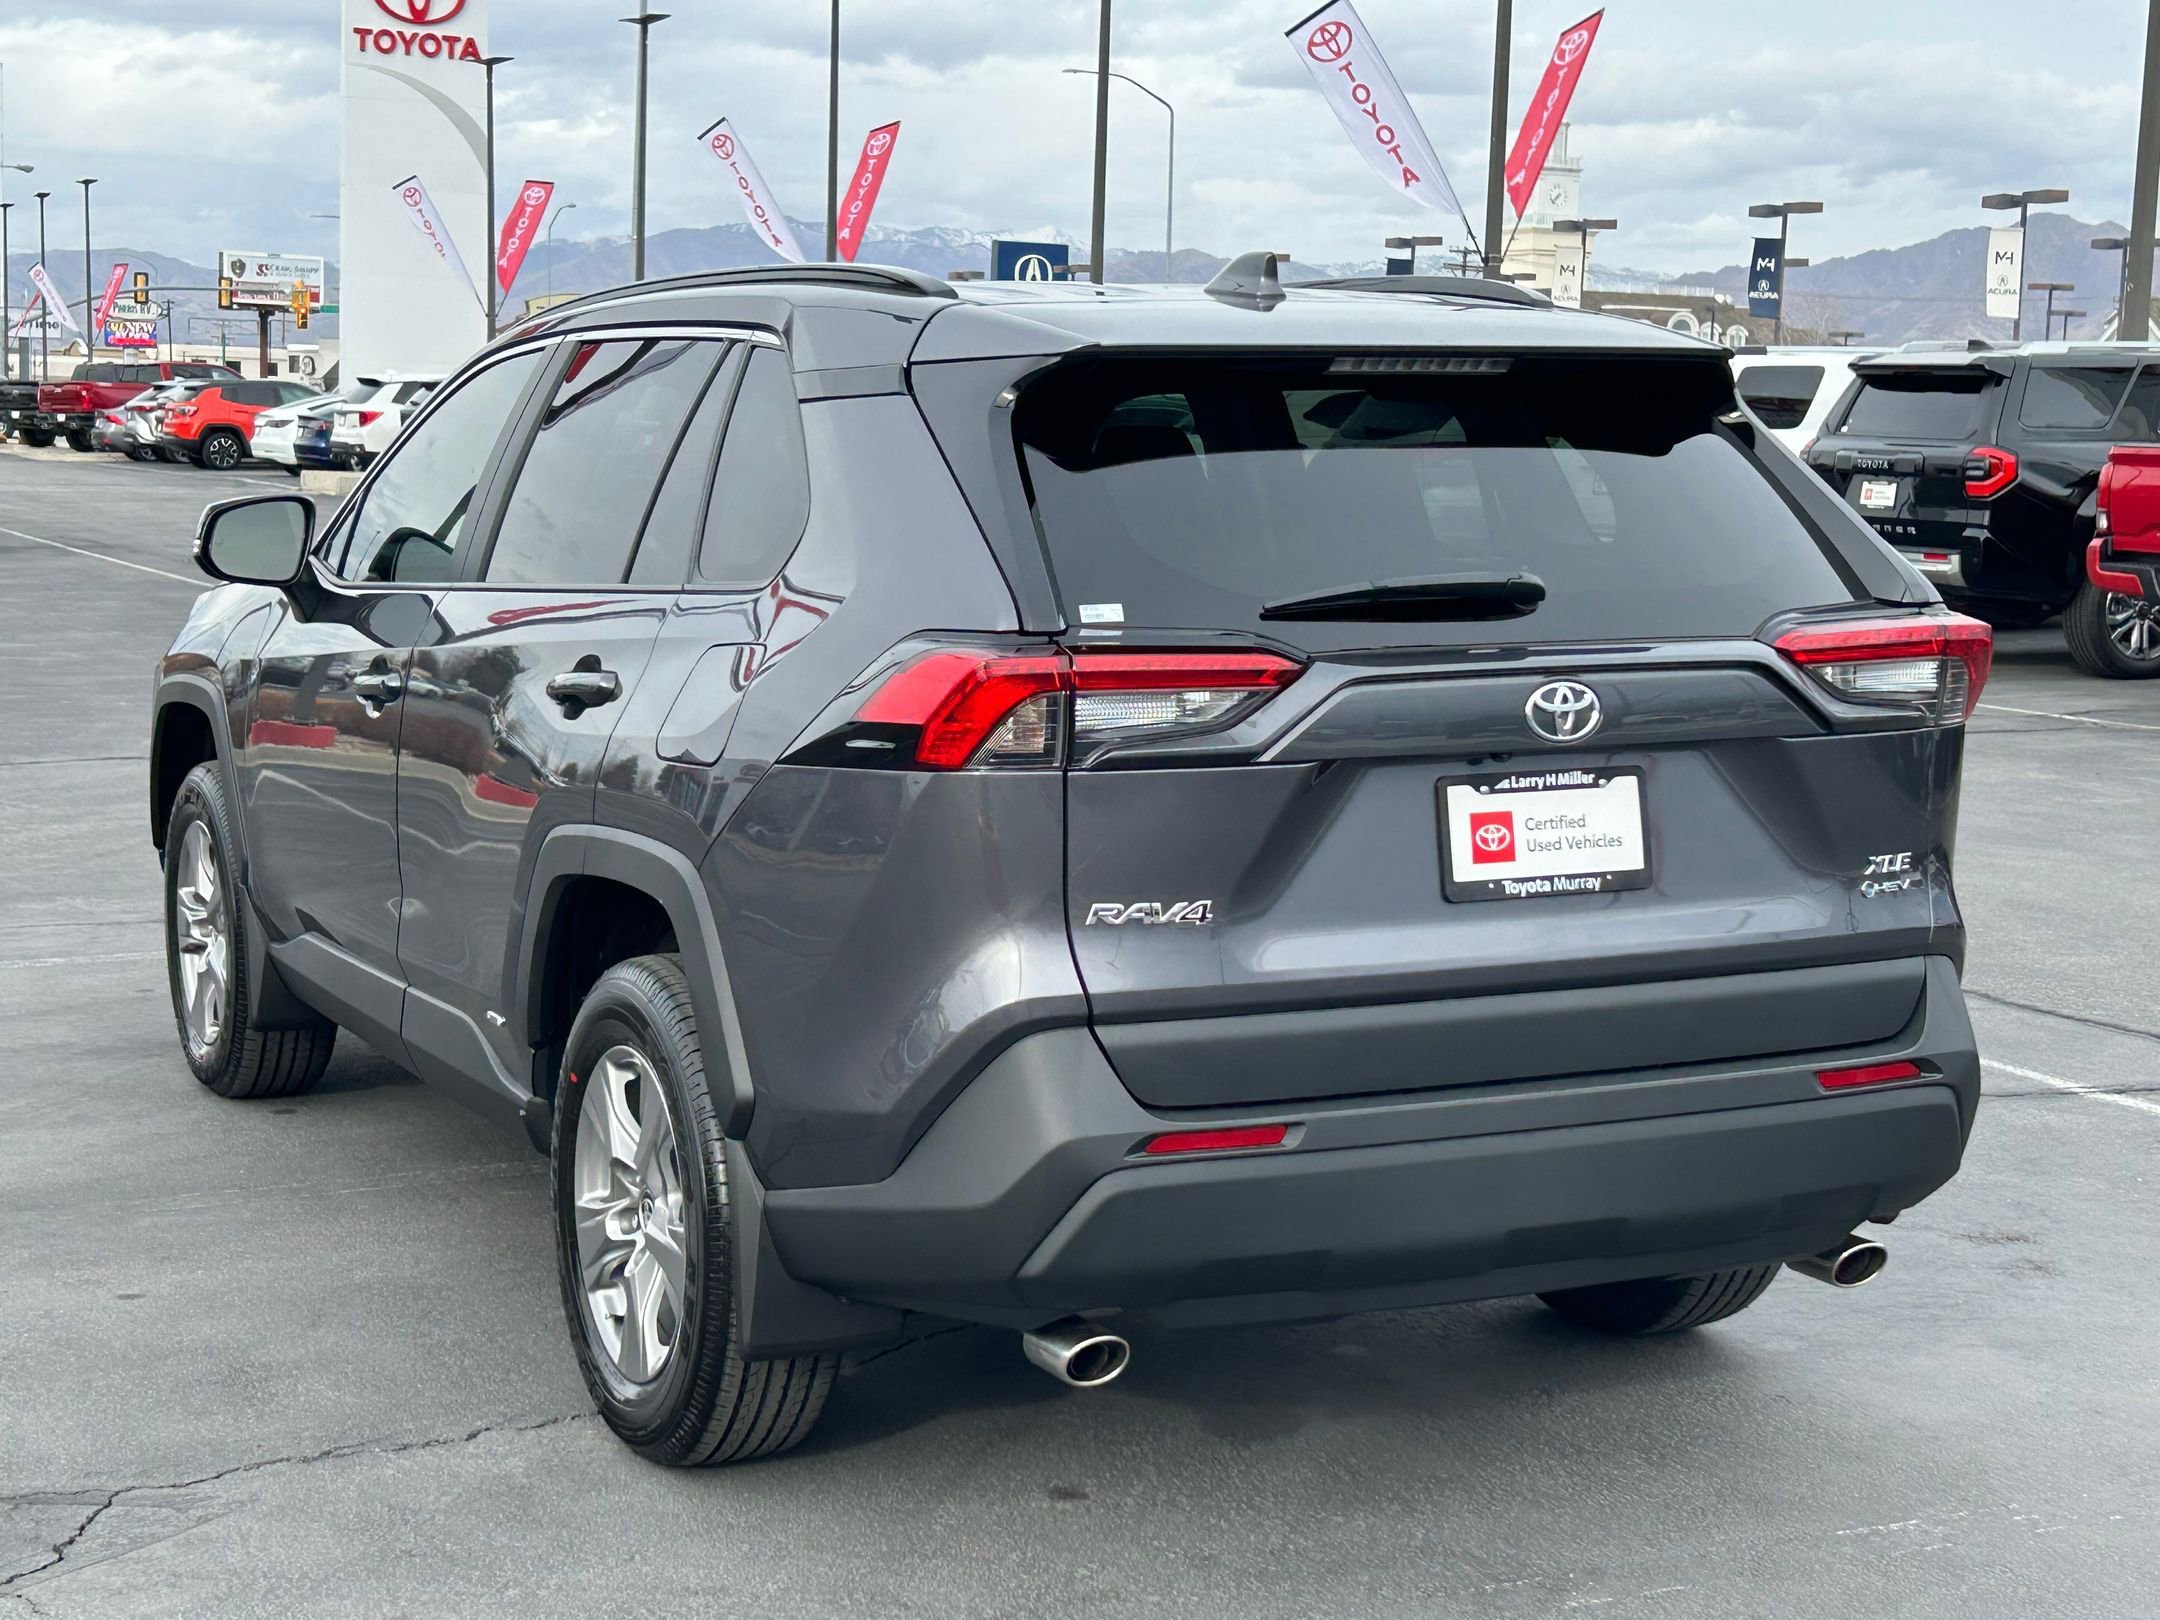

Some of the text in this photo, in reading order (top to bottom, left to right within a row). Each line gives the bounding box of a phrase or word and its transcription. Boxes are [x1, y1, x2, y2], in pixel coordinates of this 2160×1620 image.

[353, 27, 482, 61] TOYOTA
[1338, 61, 1421, 188] TOYOTA
[1509, 67, 1568, 186] TOYOTA
[730, 161, 783, 248] TOYOTA
[839, 159, 878, 240] TOYOTA
[499, 207, 534, 269] TOYOTA
[1749, 291, 1779, 299] ACURA
[1857, 459, 1889, 469] TOYOTA
[1511, 770, 1596, 790] Larry H Miller
[1525, 814, 1586, 831] Certified
[1526, 833, 1623, 852] Used Vehicles
[1864, 852, 1912, 875] XLE
[1502, 875, 1601, 897] Toyota Murray
[1085, 900, 1213, 925] RAV4
